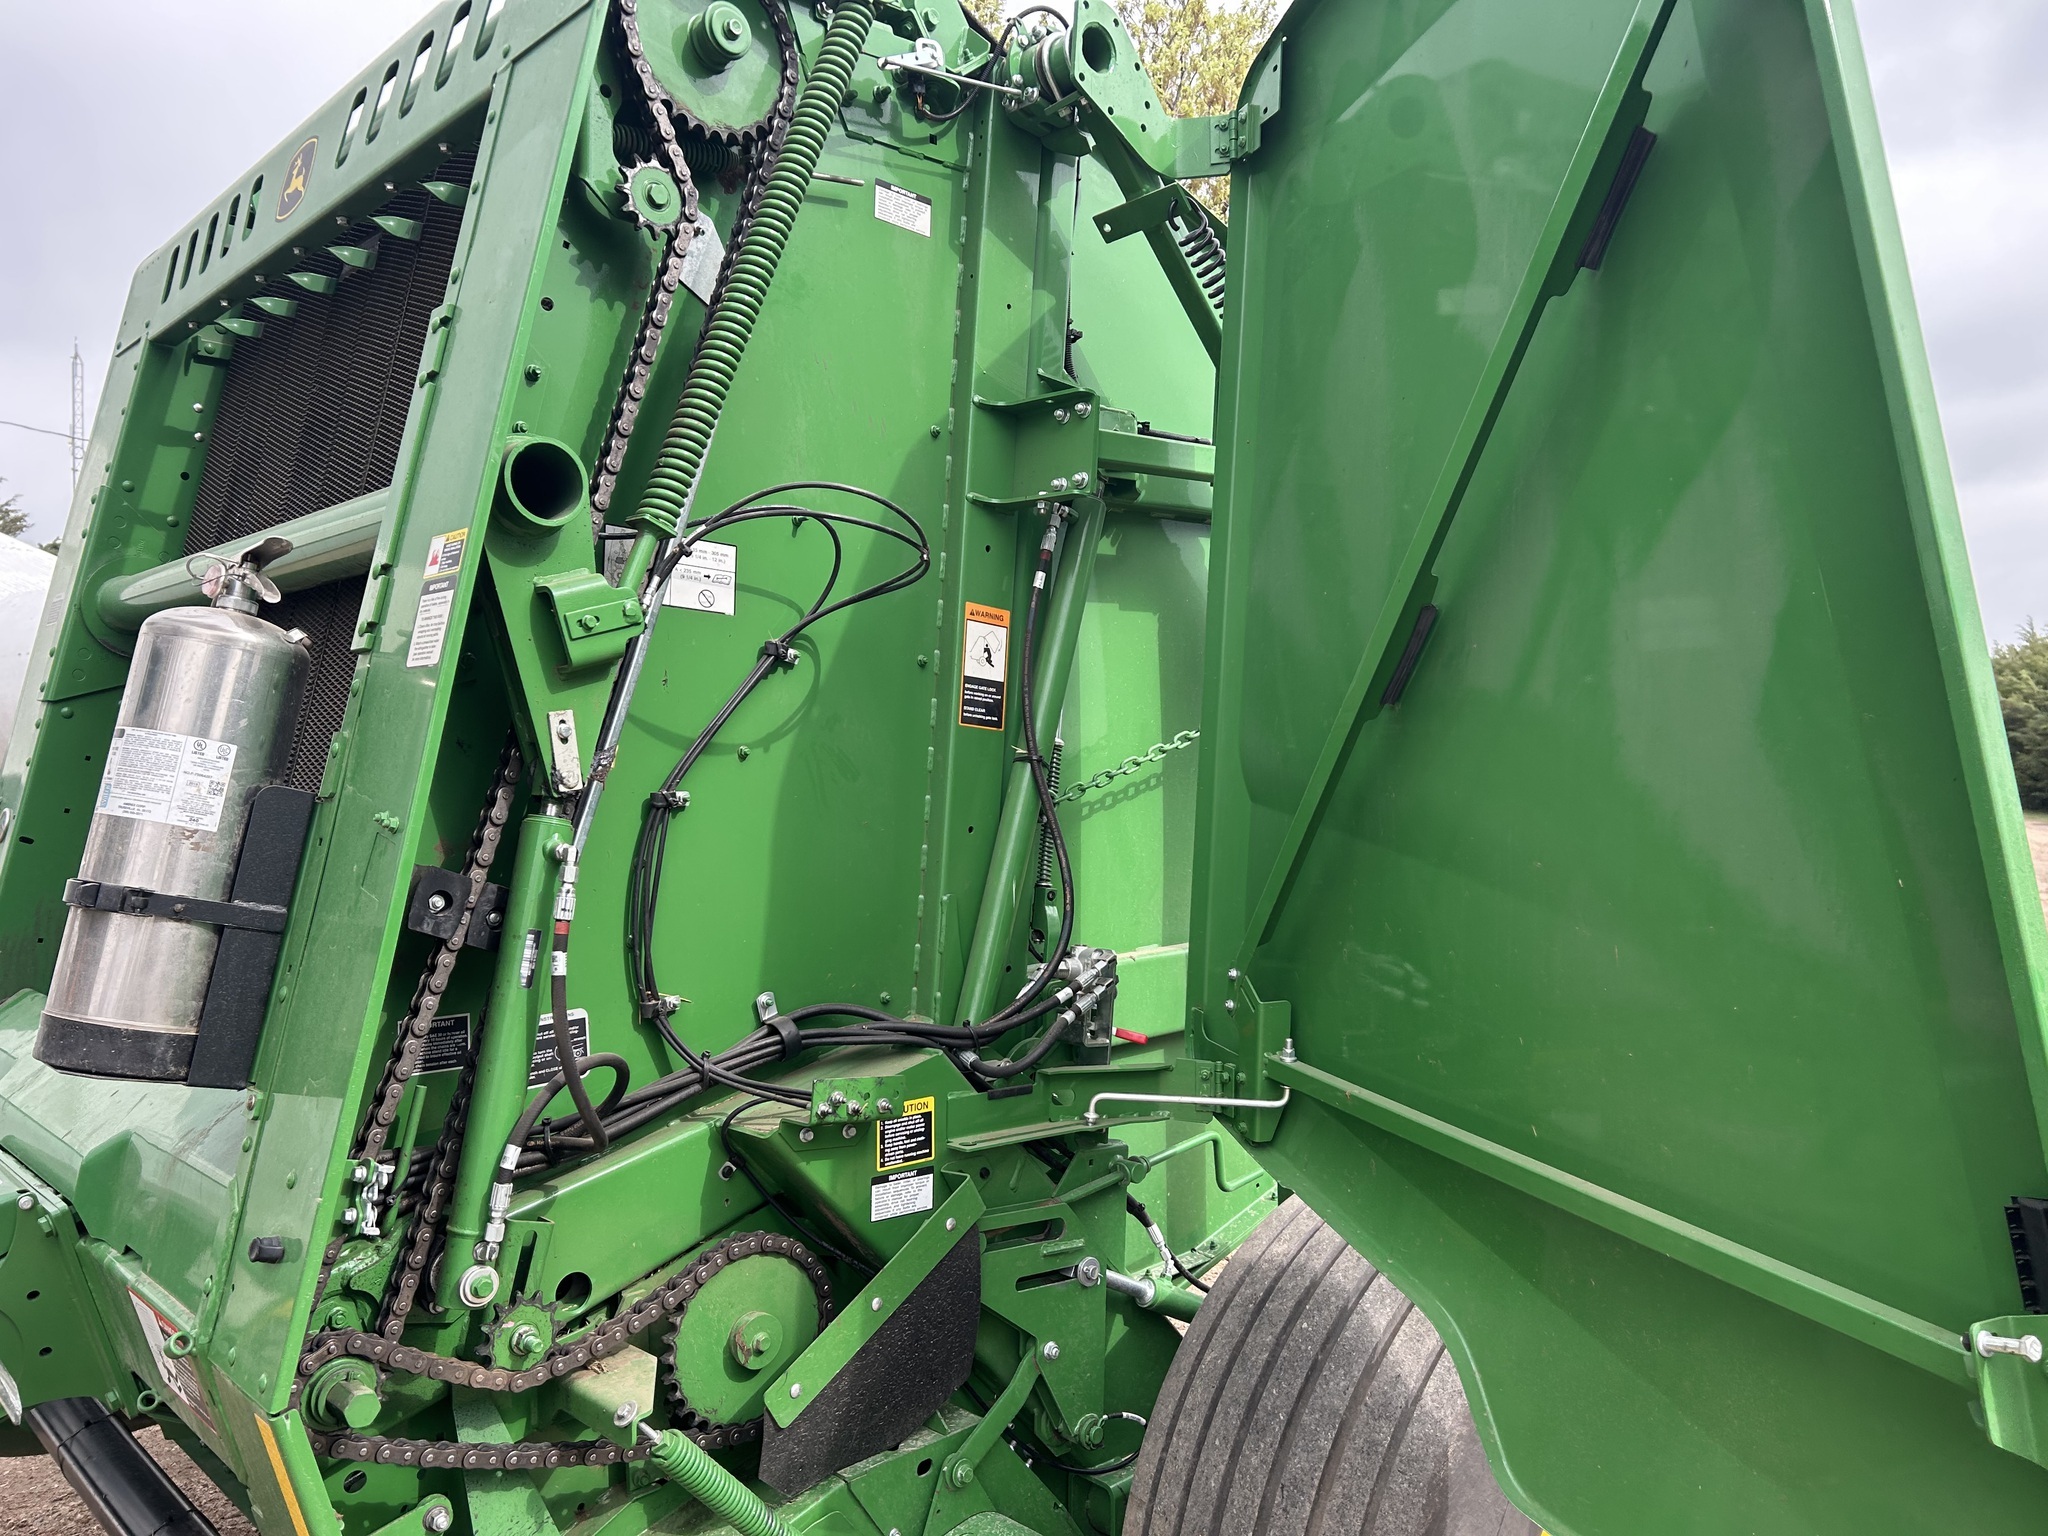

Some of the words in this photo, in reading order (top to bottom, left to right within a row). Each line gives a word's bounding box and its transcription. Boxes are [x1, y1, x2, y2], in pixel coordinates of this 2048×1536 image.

[975, 610, 1004, 622] WARNING
[904, 1101, 929, 1114] UTION
[888, 1170, 918, 1181] IMPORTANT
